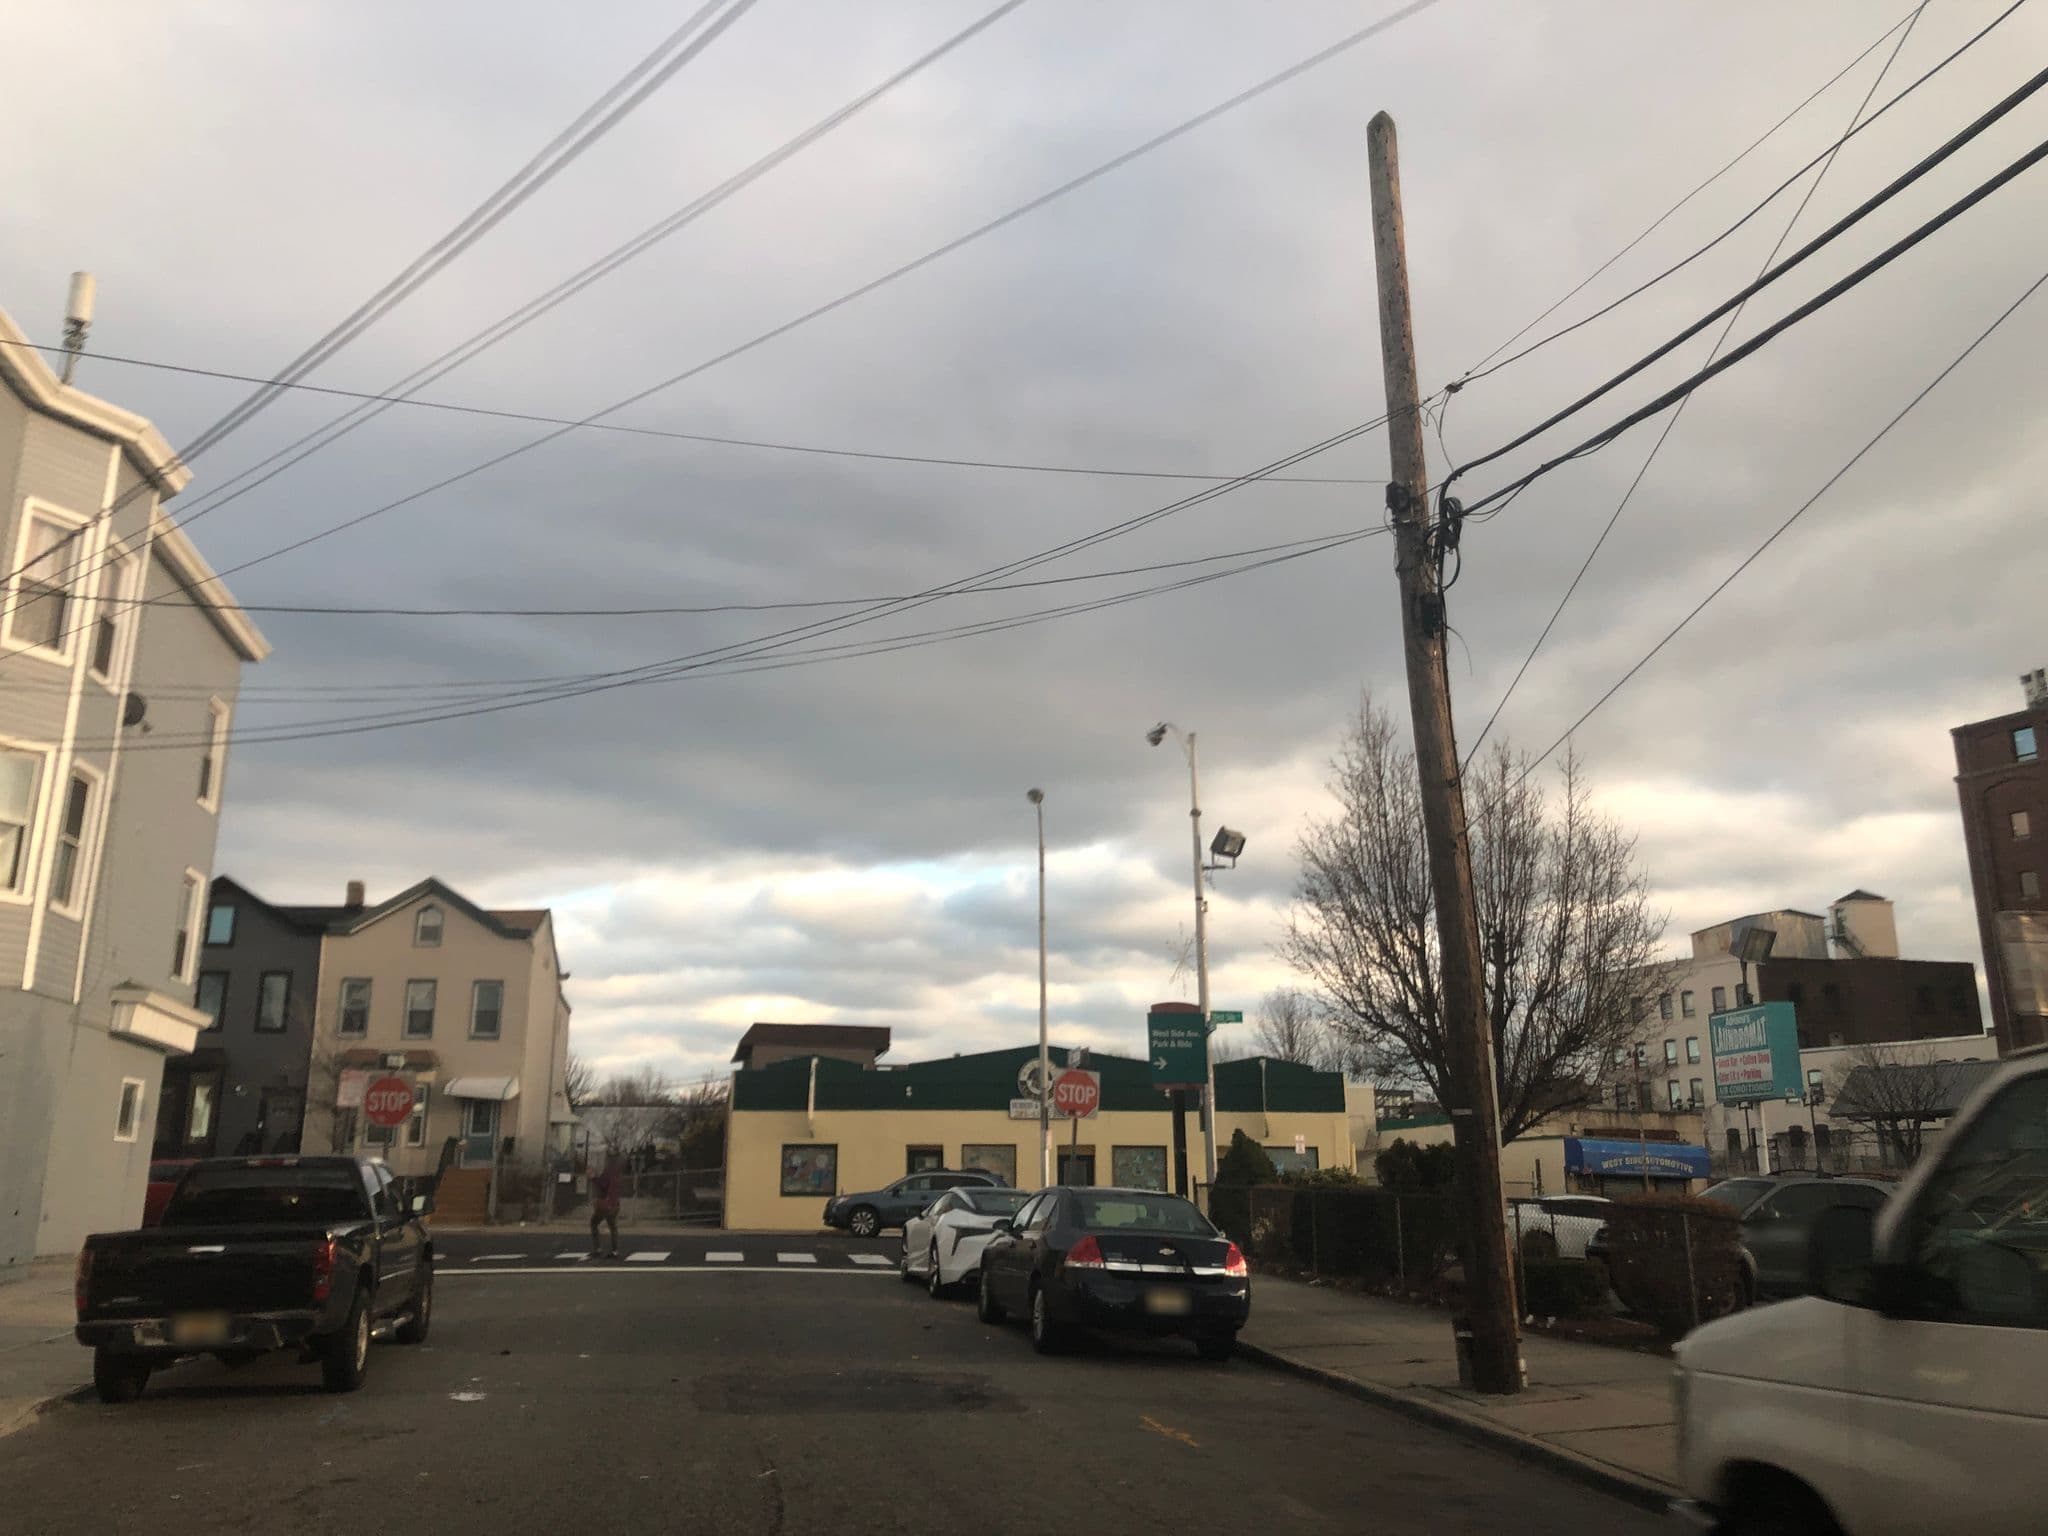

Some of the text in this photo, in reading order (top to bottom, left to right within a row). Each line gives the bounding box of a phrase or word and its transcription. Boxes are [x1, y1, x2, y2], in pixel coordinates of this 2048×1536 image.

[1152, 1030, 1169, 1038] West
[1170, 1029, 1185, 1038] Side
[1713, 1015, 1766, 1052] LAUNDROMAT
[1152, 1039, 1192, 1048] Park & Ride
[369, 1092, 410, 1111] STOP
[1057, 1083, 1096, 1104] STOP
[1602, 1157, 1623, 1169] WEST
[1645, 1157, 1693, 1173] AUTOMOTIVE
